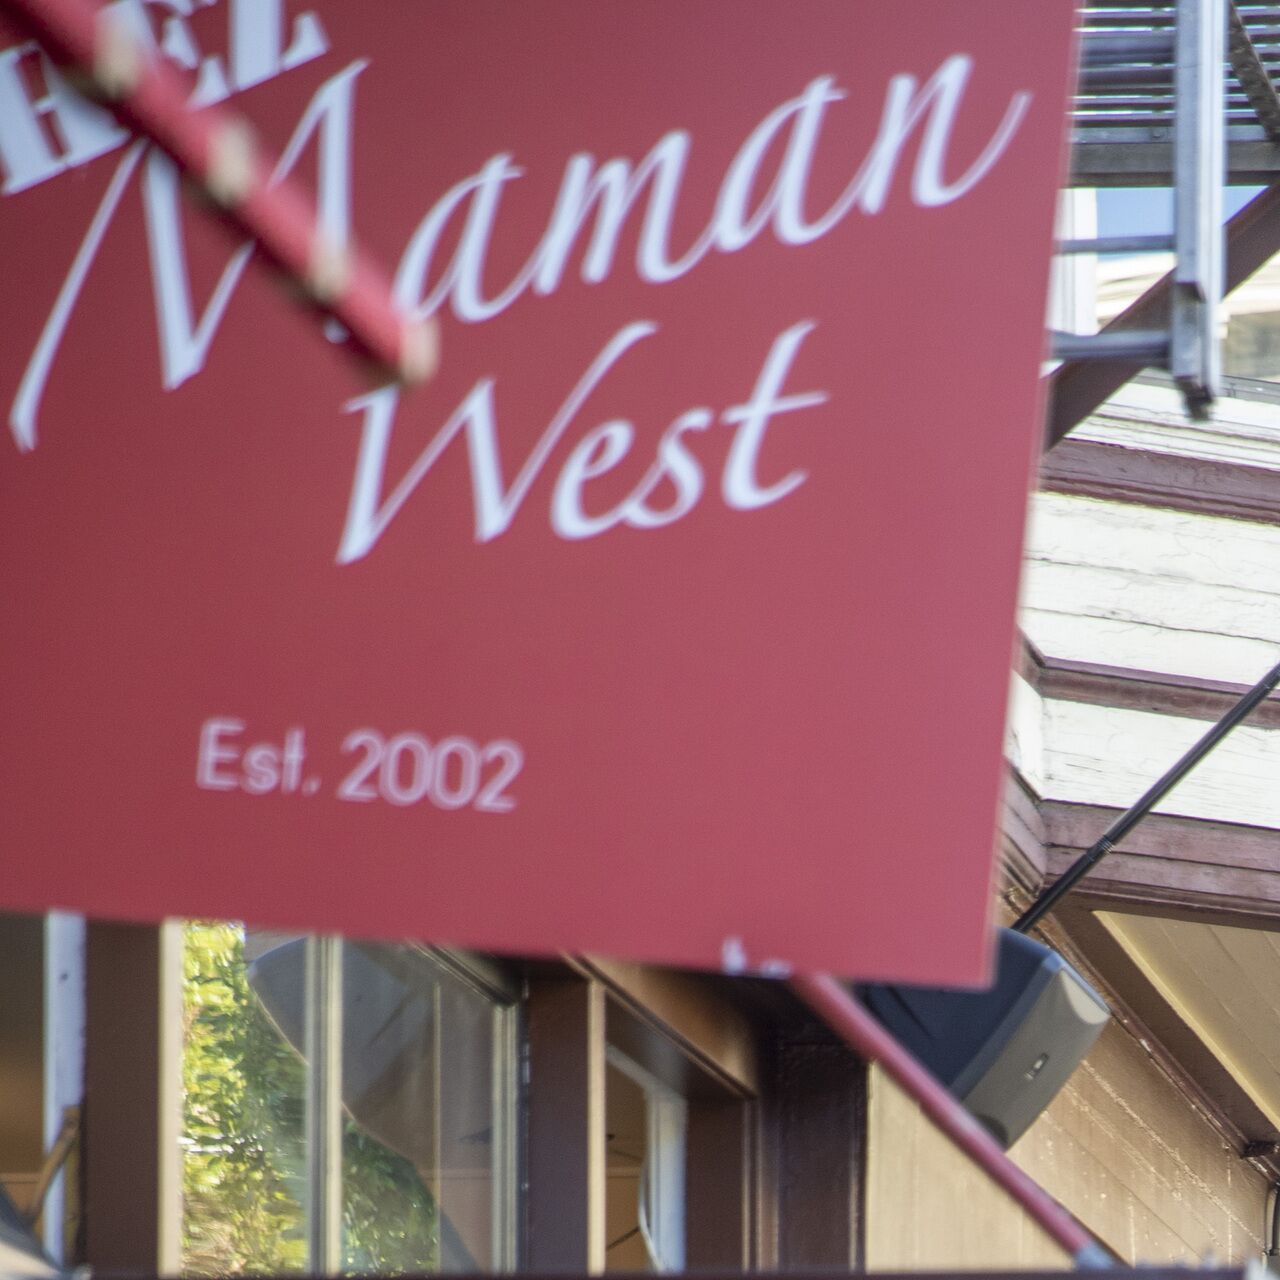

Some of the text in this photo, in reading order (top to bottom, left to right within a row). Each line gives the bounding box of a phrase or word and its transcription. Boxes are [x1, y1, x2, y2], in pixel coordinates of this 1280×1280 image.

[9, 54, 1033, 452] Maman
[334, 319, 829, 567] West
[196, 716, 524, 813] Est. 2002
